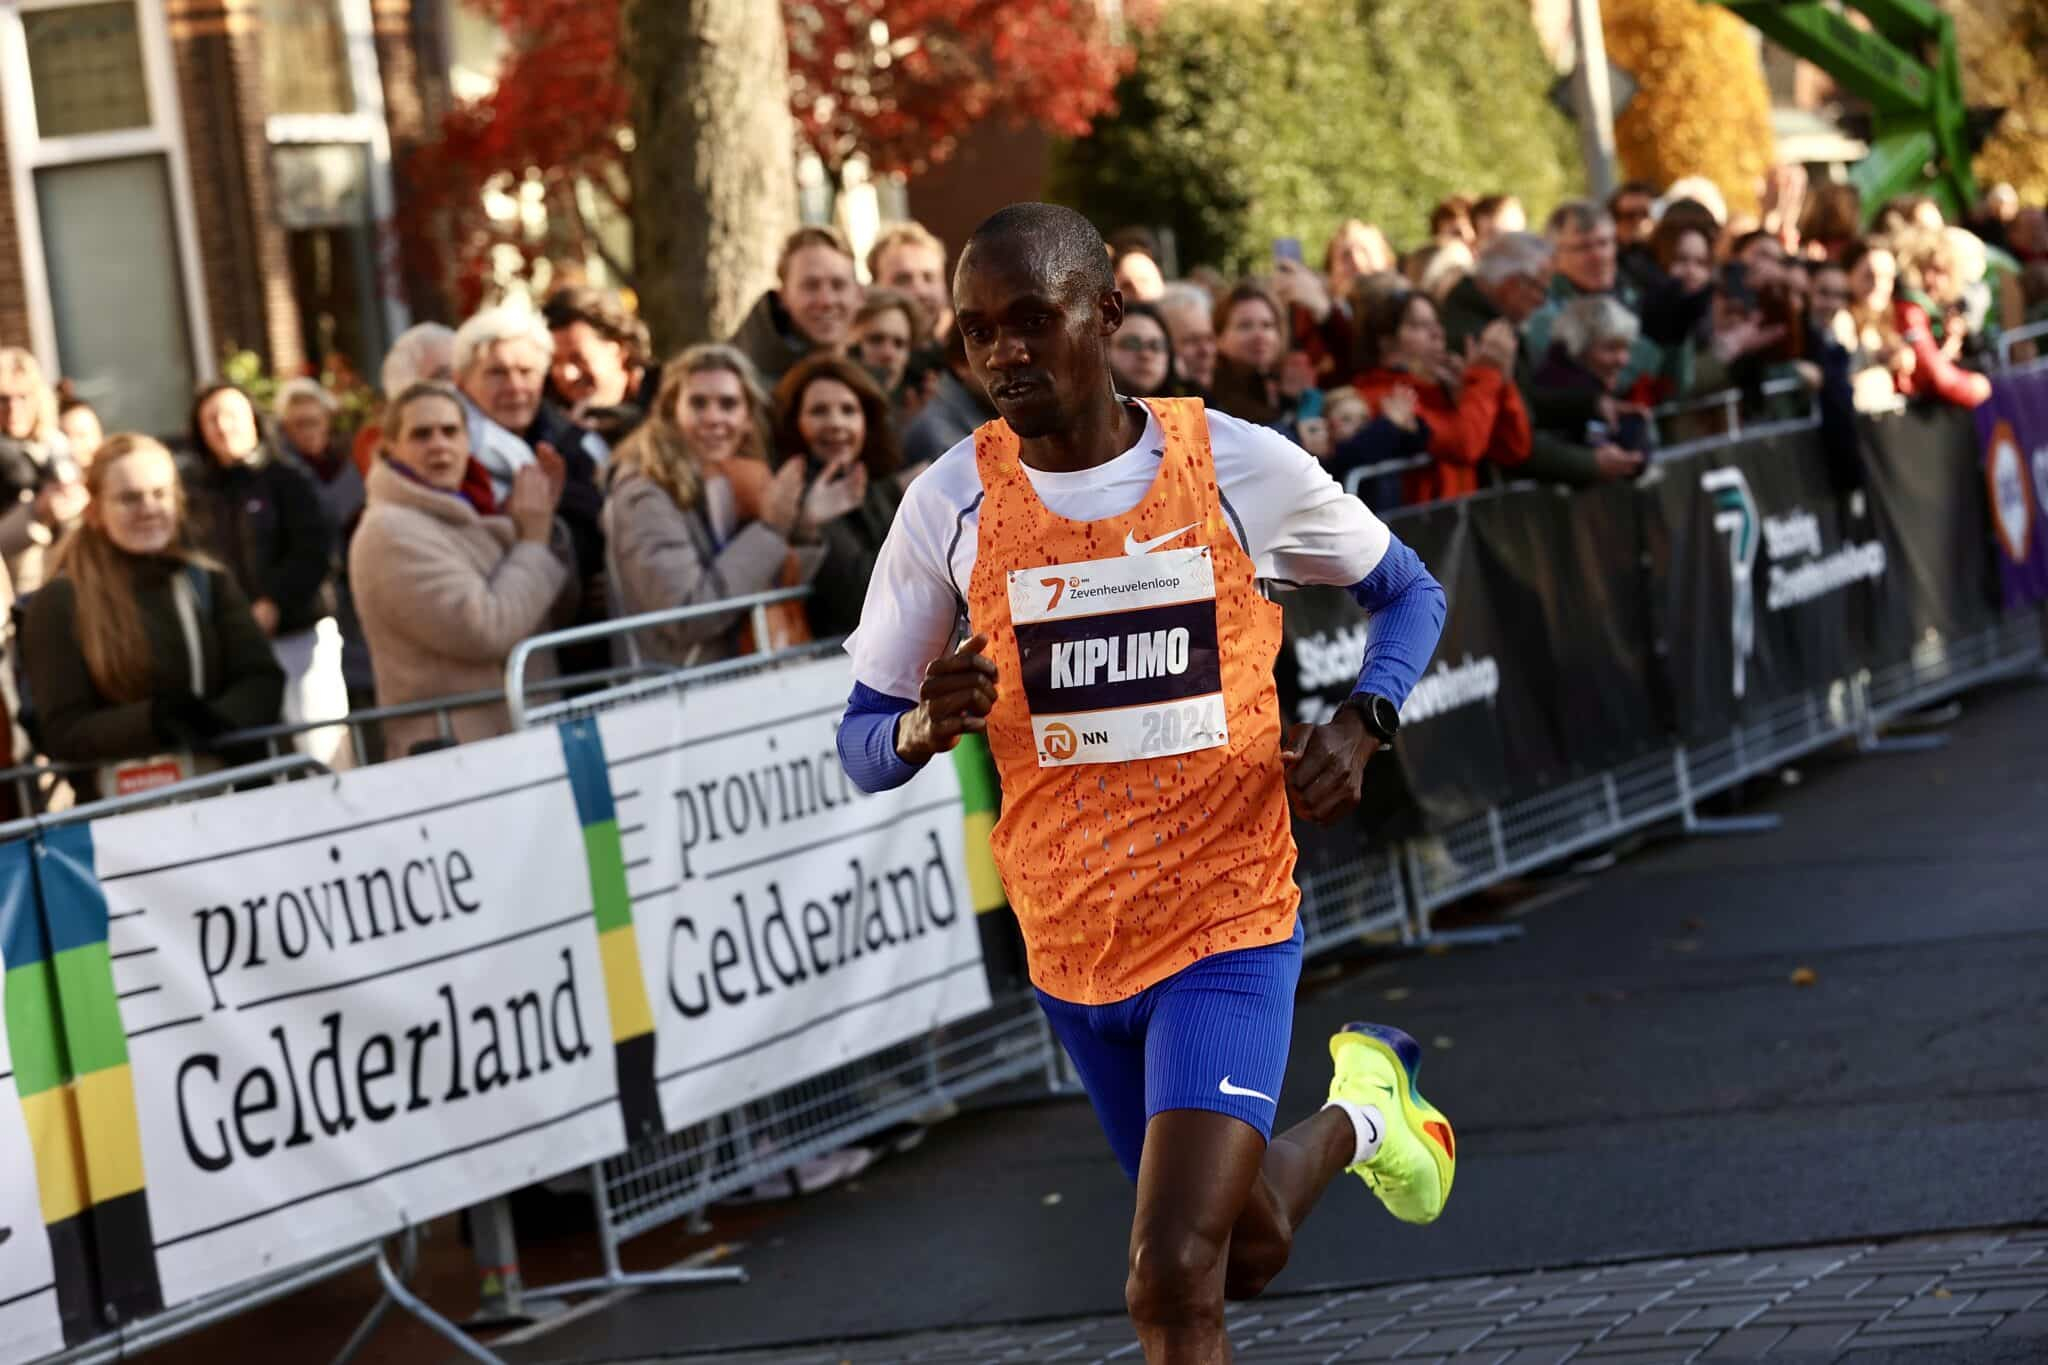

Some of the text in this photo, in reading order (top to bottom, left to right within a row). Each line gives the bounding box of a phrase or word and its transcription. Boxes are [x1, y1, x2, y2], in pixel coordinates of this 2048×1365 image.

[1040, 576, 1180, 612] 7 Zevenheuvelenloop
[1051, 627, 1190, 689] KIPLIMO
[1082, 731, 1108, 745] NN
[1141, 702, 1215, 755] 2024
[194, 827, 482, 1011] provincie
[667, 830, 957, 1019] Gelderland
[175, 948, 593, 1172] Gelderland
